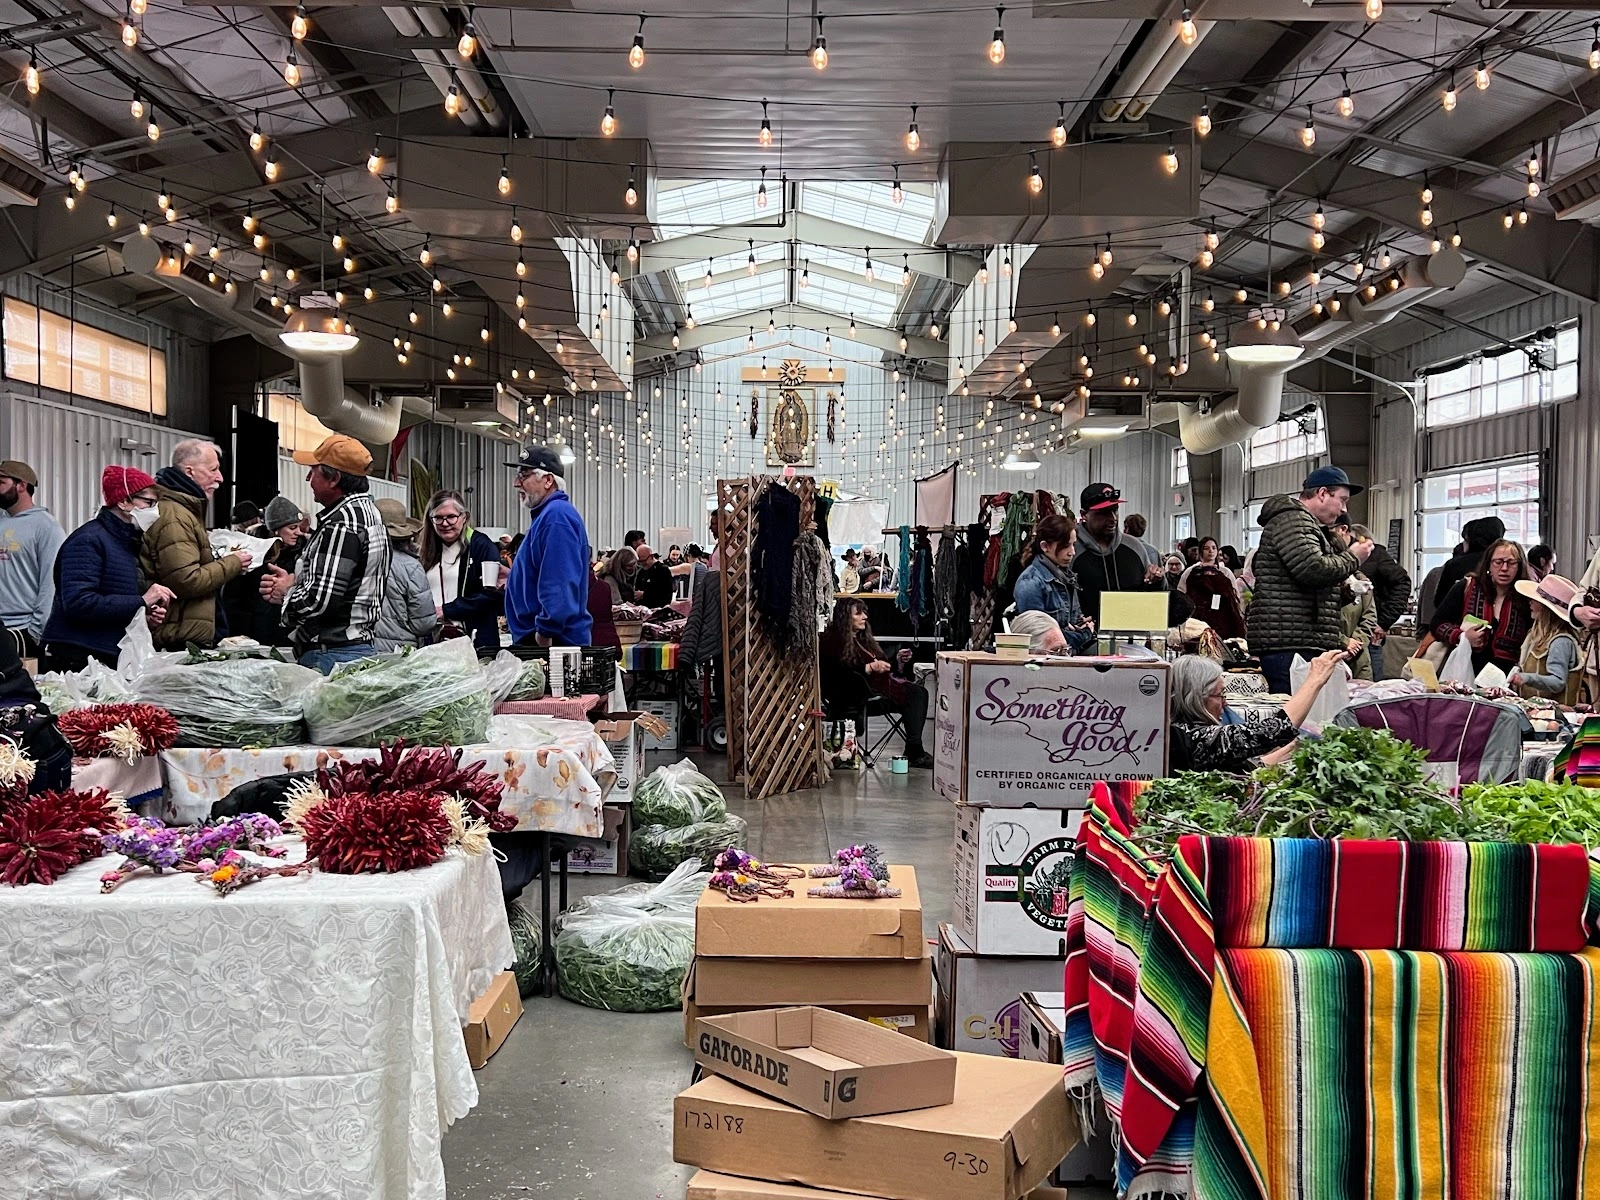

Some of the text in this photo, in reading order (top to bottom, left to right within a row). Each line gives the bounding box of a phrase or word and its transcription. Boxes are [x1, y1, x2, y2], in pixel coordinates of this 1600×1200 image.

[975, 677, 1127, 735] Something
[1049, 720, 1160, 764] Good!
[976, 770, 1154, 782] CERTIFIED ORGANICALLY GROWN
[1016, 782, 1065, 790] ORGANIC
[1069, 782, 1096, 790] CER
[1026, 841, 1060, 866] FARM
[985, 878, 1017, 888] Quality
[699, 1032, 789, 1087] GATORADE
[685, 1111, 744, 1134] 172188
[943, 1151, 989, 1176] 9-30
